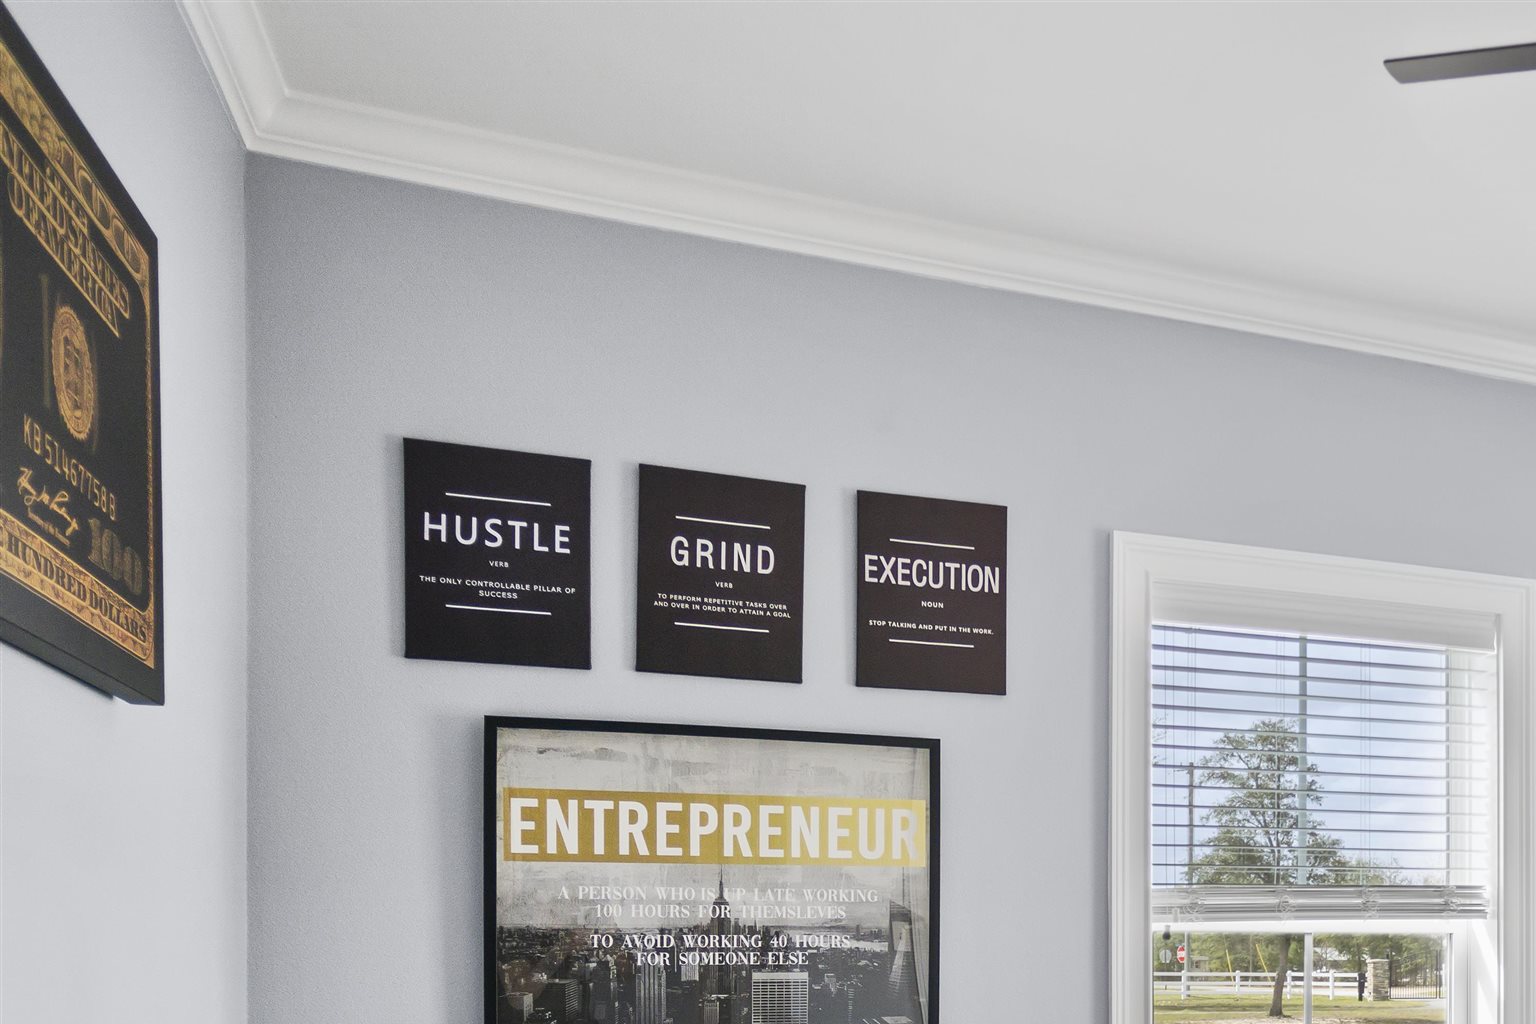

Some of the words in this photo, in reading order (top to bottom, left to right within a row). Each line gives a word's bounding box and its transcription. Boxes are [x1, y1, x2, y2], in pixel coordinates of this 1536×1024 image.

[423, 511, 571, 554] HUSTLE
[670, 535, 775, 575] GRIND
[488, 560, 509, 568] VERB
[864, 554, 1000, 594] EXECUTION
[7, 532, 87, 602] HUNDRED
[89, 594, 148, 642] DOLLARS
[419, 575, 436, 583] THE
[439, 577, 462, 585] ONLY
[465, 579, 530, 591] CONTROLLABLE
[533, 585, 562, 594] PILLAR
[715, 581, 733, 589] VERB
[479, 590, 518, 599] SUCCESS
[669, 594, 702, 602] PERFORM
[704, 597, 743, 607] REPETITIVE
[745, 601, 767, 609] TASKS
[769, 603, 787, 611] OVER
[921, 600, 944, 609] NOUN
[702, 605, 726, 613] ORDER
[739, 608, 764, 616] ATTAIN
[773, 611, 791, 619] GOAL
[888, 621, 917, 629] TALKING
[972, 627, 994, 635] WORK.
[509, 797, 921, 861] ENTREPRENEUR
[558, 885, 570, 900] A
[578, 885, 647, 900] PERSON
[655, 886, 696, 901] WHO
[701, 887, 716, 900] IS
[723, 887, 746, 901] UP
[754, 887, 795, 902] LATE
[803, 888, 879, 903] WORKING
[595, 904, 622, 918] 100
[631, 904, 690, 918] HOURS
[698, 904, 731, 919] FOR
[739, 904, 847, 919] THEMSLEVES
[590, 934, 614, 948] TO
[621, 934, 675, 949] AVOID
[682, 934, 762, 948] WORKING
[770, 934, 788, 948] 40
[795, 934, 850, 948] HOURS
[637, 951, 671, 966] FOR
[679, 951, 760, 966] SOMEONE
[768, 951, 809, 965] ELSE
